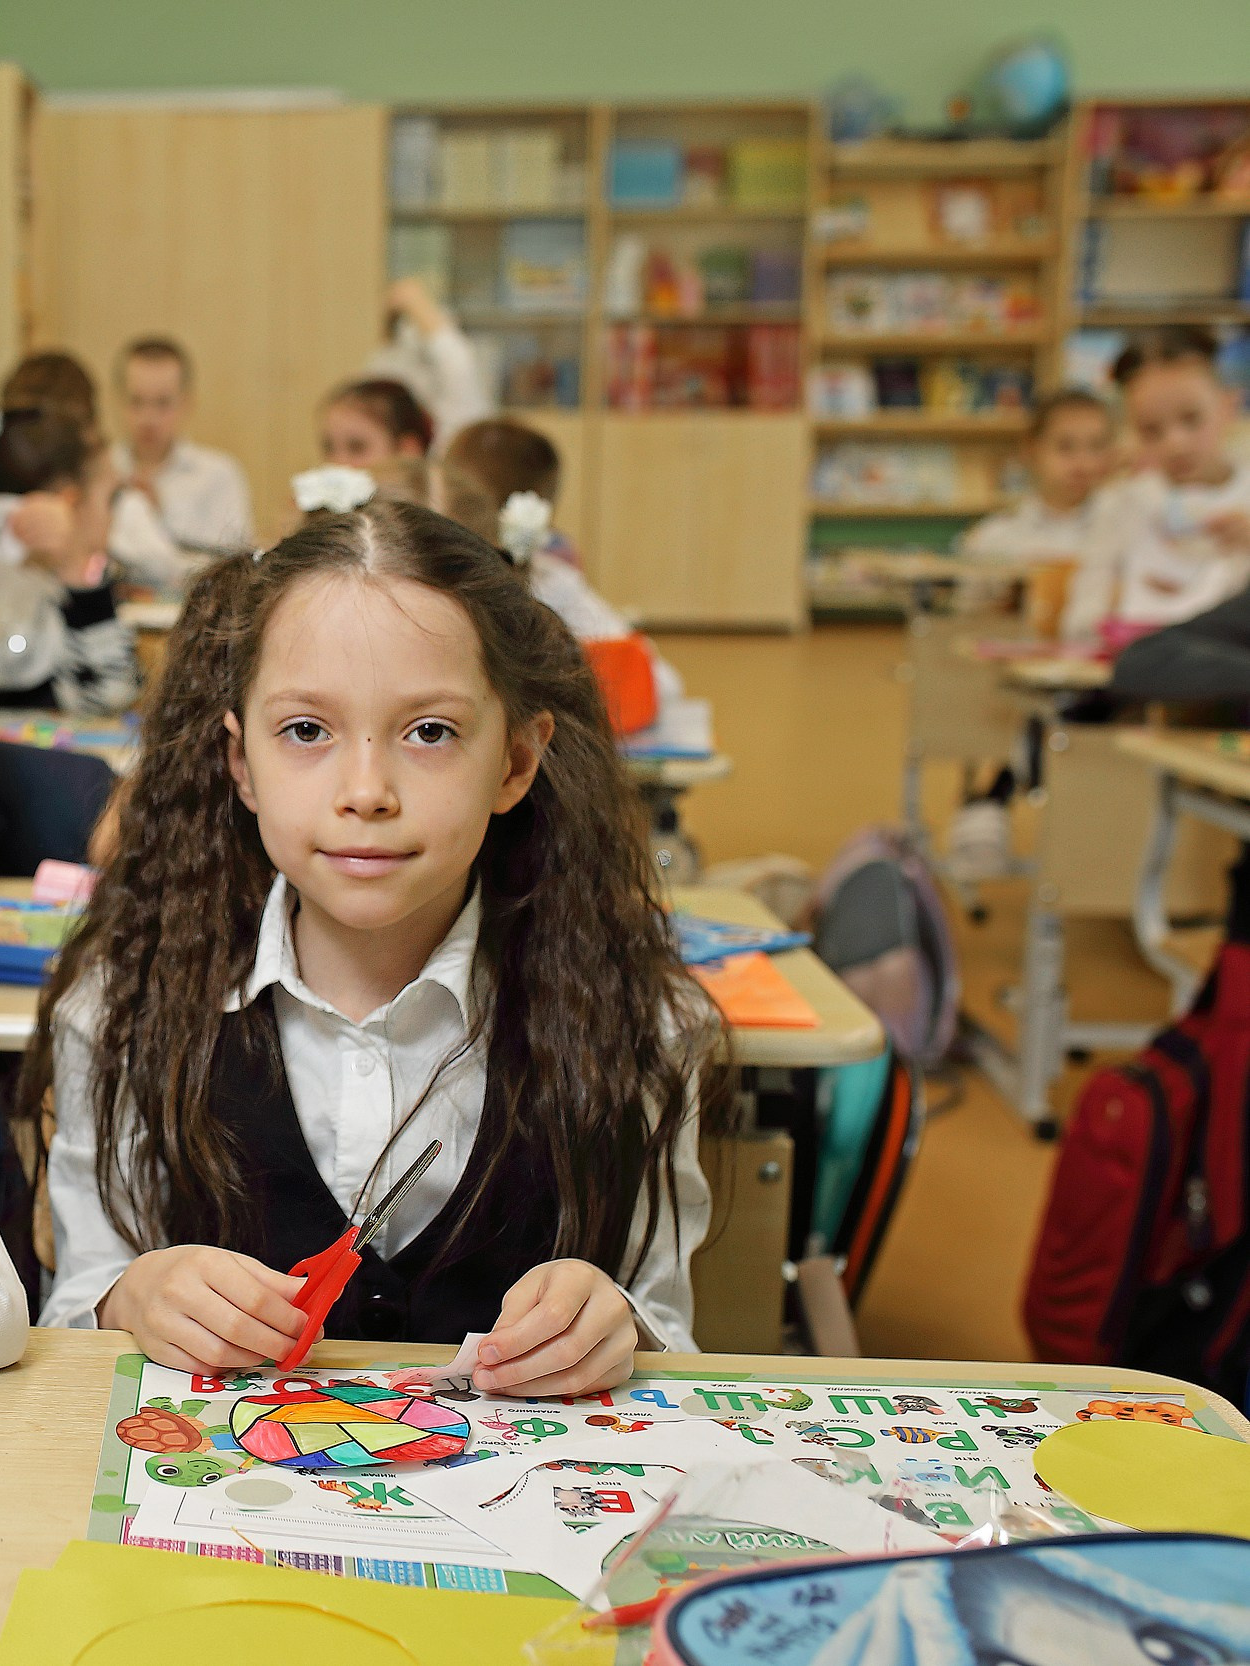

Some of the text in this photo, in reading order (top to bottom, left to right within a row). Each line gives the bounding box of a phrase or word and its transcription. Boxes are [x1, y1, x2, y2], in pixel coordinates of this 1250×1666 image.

[190, 1374, 227, 1393] Я
[692, 1387, 769, 1412] Щ
[828, 1394, 899, 1416] Ш
[513, 1416, 569, 1438] Ф
[826, 1427, 876, 1448] С
[937, 1429, 979, 1452] Р
